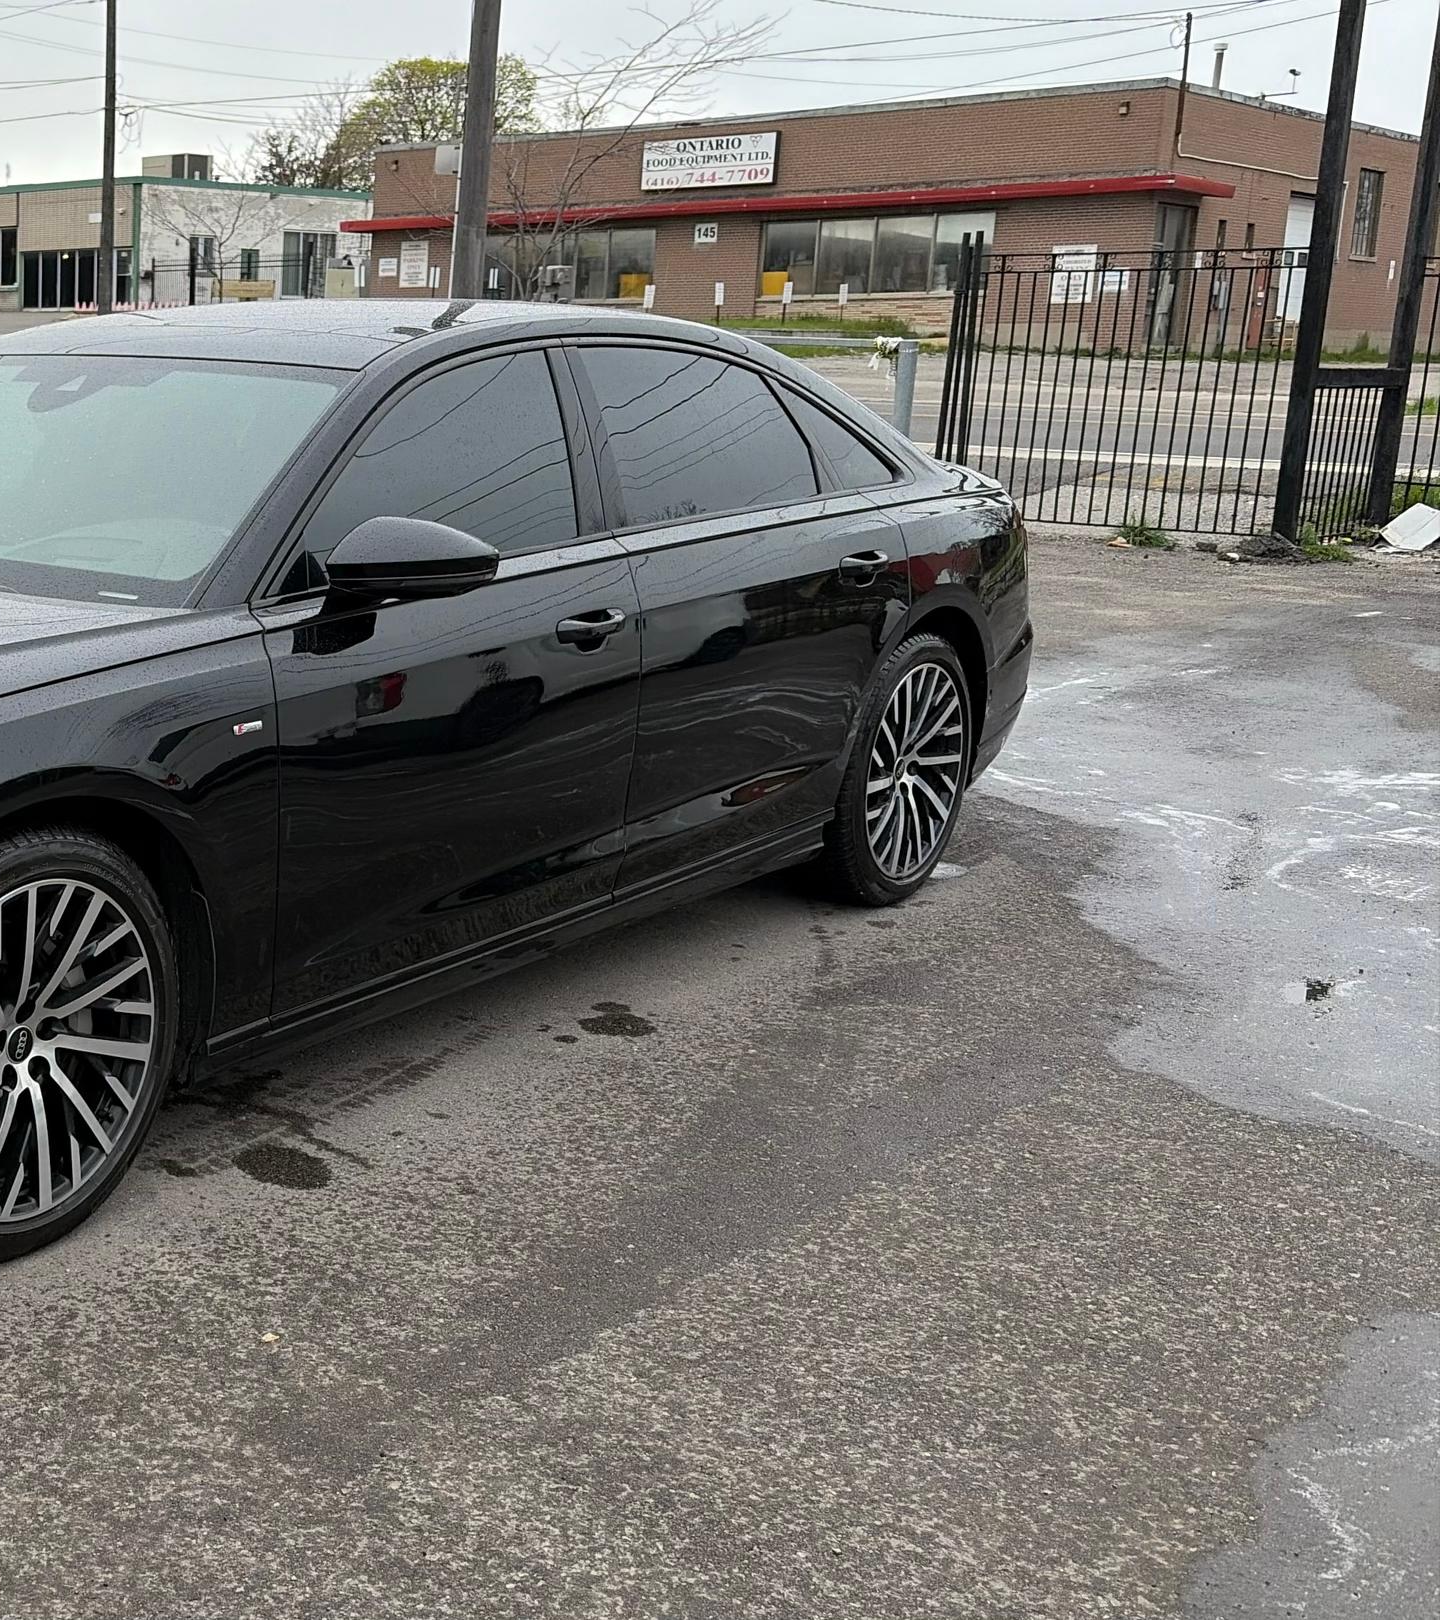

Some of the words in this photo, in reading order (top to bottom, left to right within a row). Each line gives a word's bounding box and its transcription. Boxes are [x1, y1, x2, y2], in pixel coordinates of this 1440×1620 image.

[676, 137, 742, 153] ONTARIO
[646, 157, 677, 168] FOOD
[679, 152, 744, 167] EQUIPMENT
[747, 150, 772, 161] LTD.
[646, 175, 679, 187] (416)
[685, 167, 770, 184] 744-7709
[696, 226, 716, 239] 145
